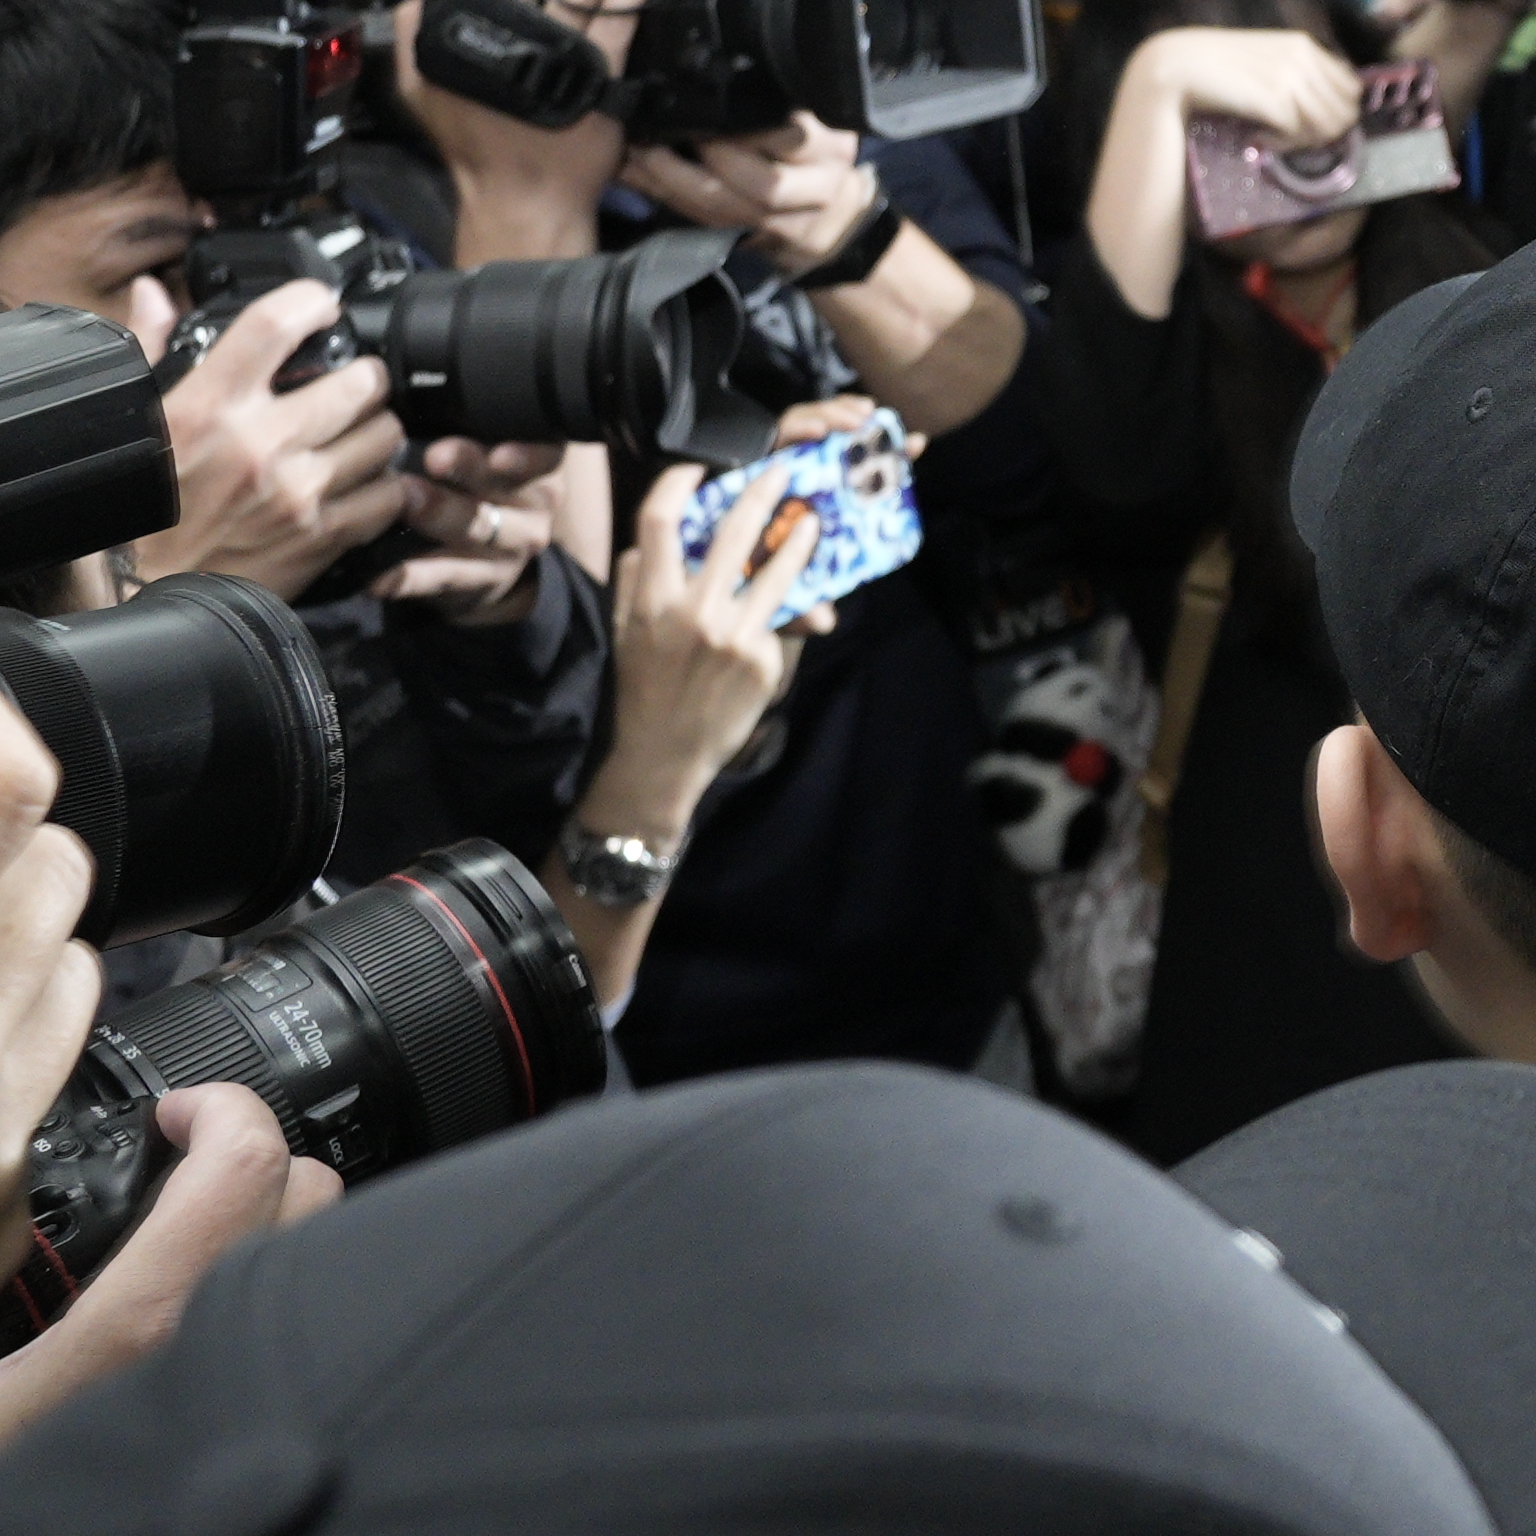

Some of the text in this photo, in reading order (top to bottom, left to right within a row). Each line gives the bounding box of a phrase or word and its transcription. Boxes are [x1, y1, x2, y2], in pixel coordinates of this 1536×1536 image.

[123, 1045, 142, 1060] 35
[269, 1010, 311, 1068] ULTRASONIC
[284, 1000, 332, 1069] 24-70mm
[329, 1137, 344, 1165] LOCK
